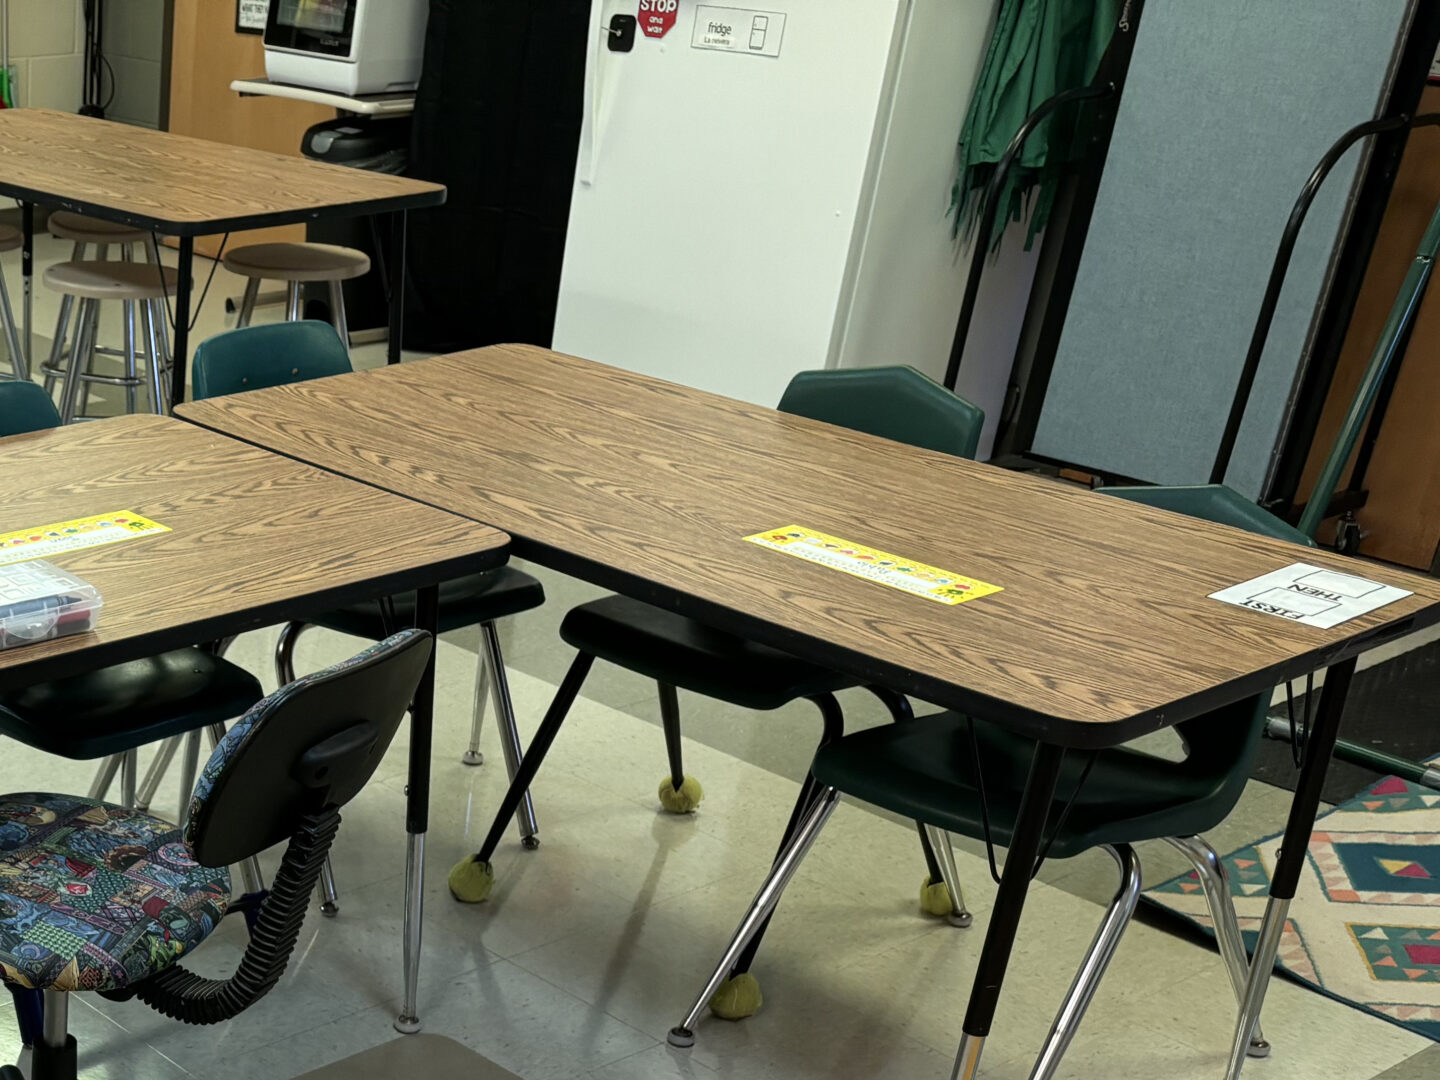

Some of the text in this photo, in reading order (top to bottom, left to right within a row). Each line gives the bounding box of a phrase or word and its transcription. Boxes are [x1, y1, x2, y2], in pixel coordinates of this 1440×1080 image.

[640, 0, 677, 13] STOP
[708, 21, 732, 36] fridge
[1287, 583, 1343, 602] THEN
[1239, 599, 1306, 620] FIRST
